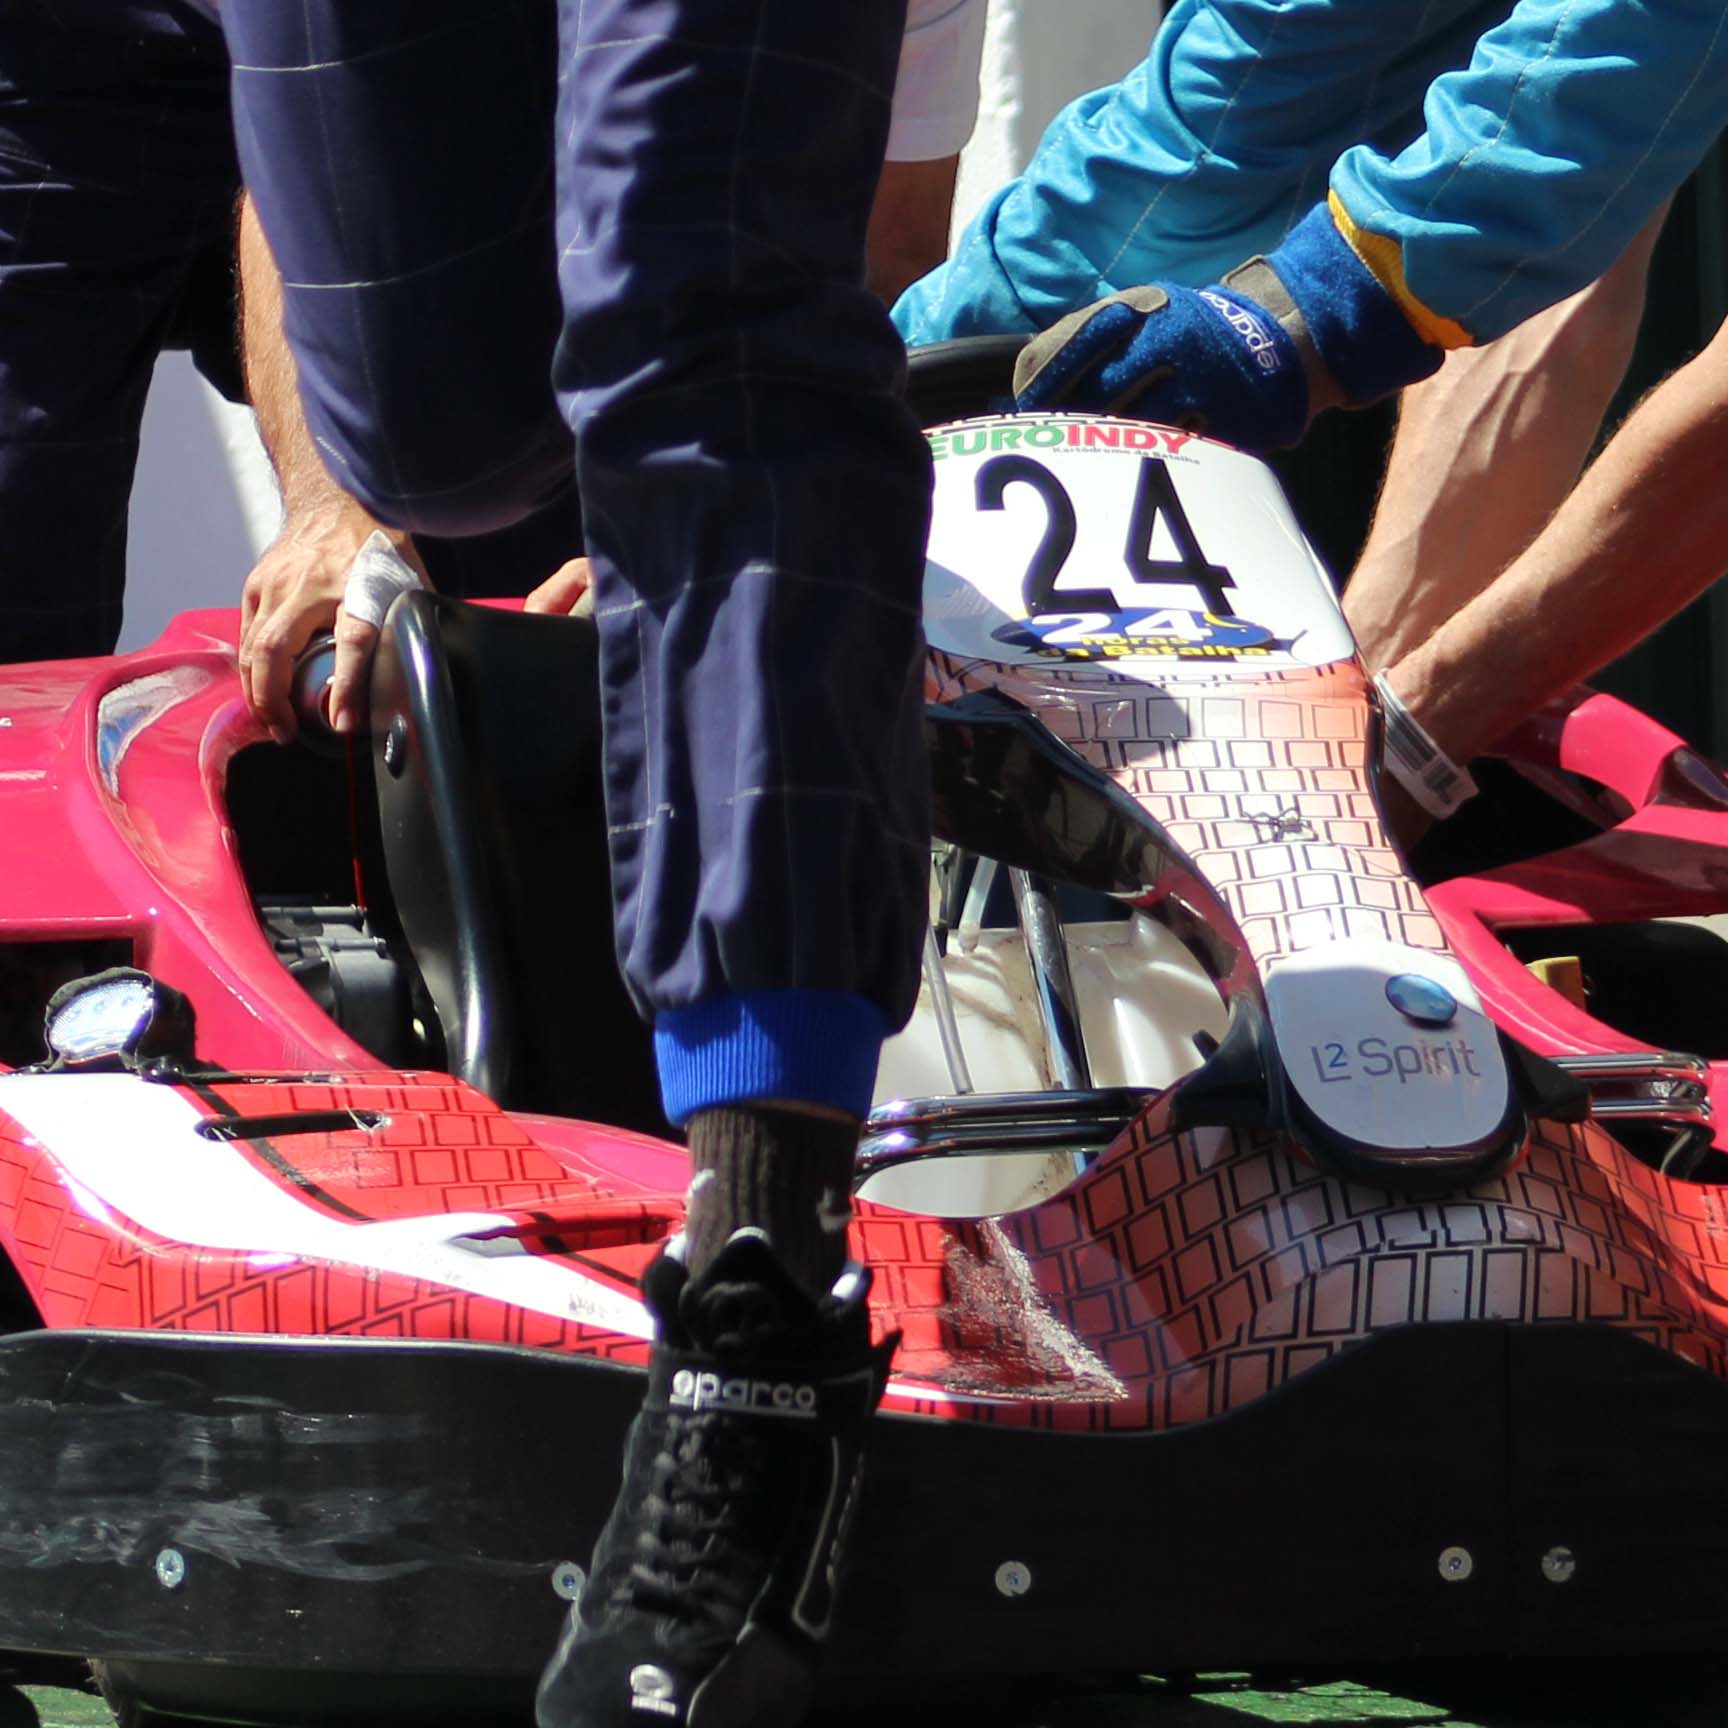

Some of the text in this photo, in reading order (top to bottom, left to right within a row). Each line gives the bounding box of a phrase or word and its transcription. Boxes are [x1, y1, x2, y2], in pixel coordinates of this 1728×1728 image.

[1199, 291, 1281, 369] sparco
[928, 422, 1190, 461] EUROINDY
[975, 453, 1238, 616] 24
[1031, 609, 1215, 643] 24
[1102, 643, 1272, 657] Batalha
[671, 1369, 818, 1418] sparco
